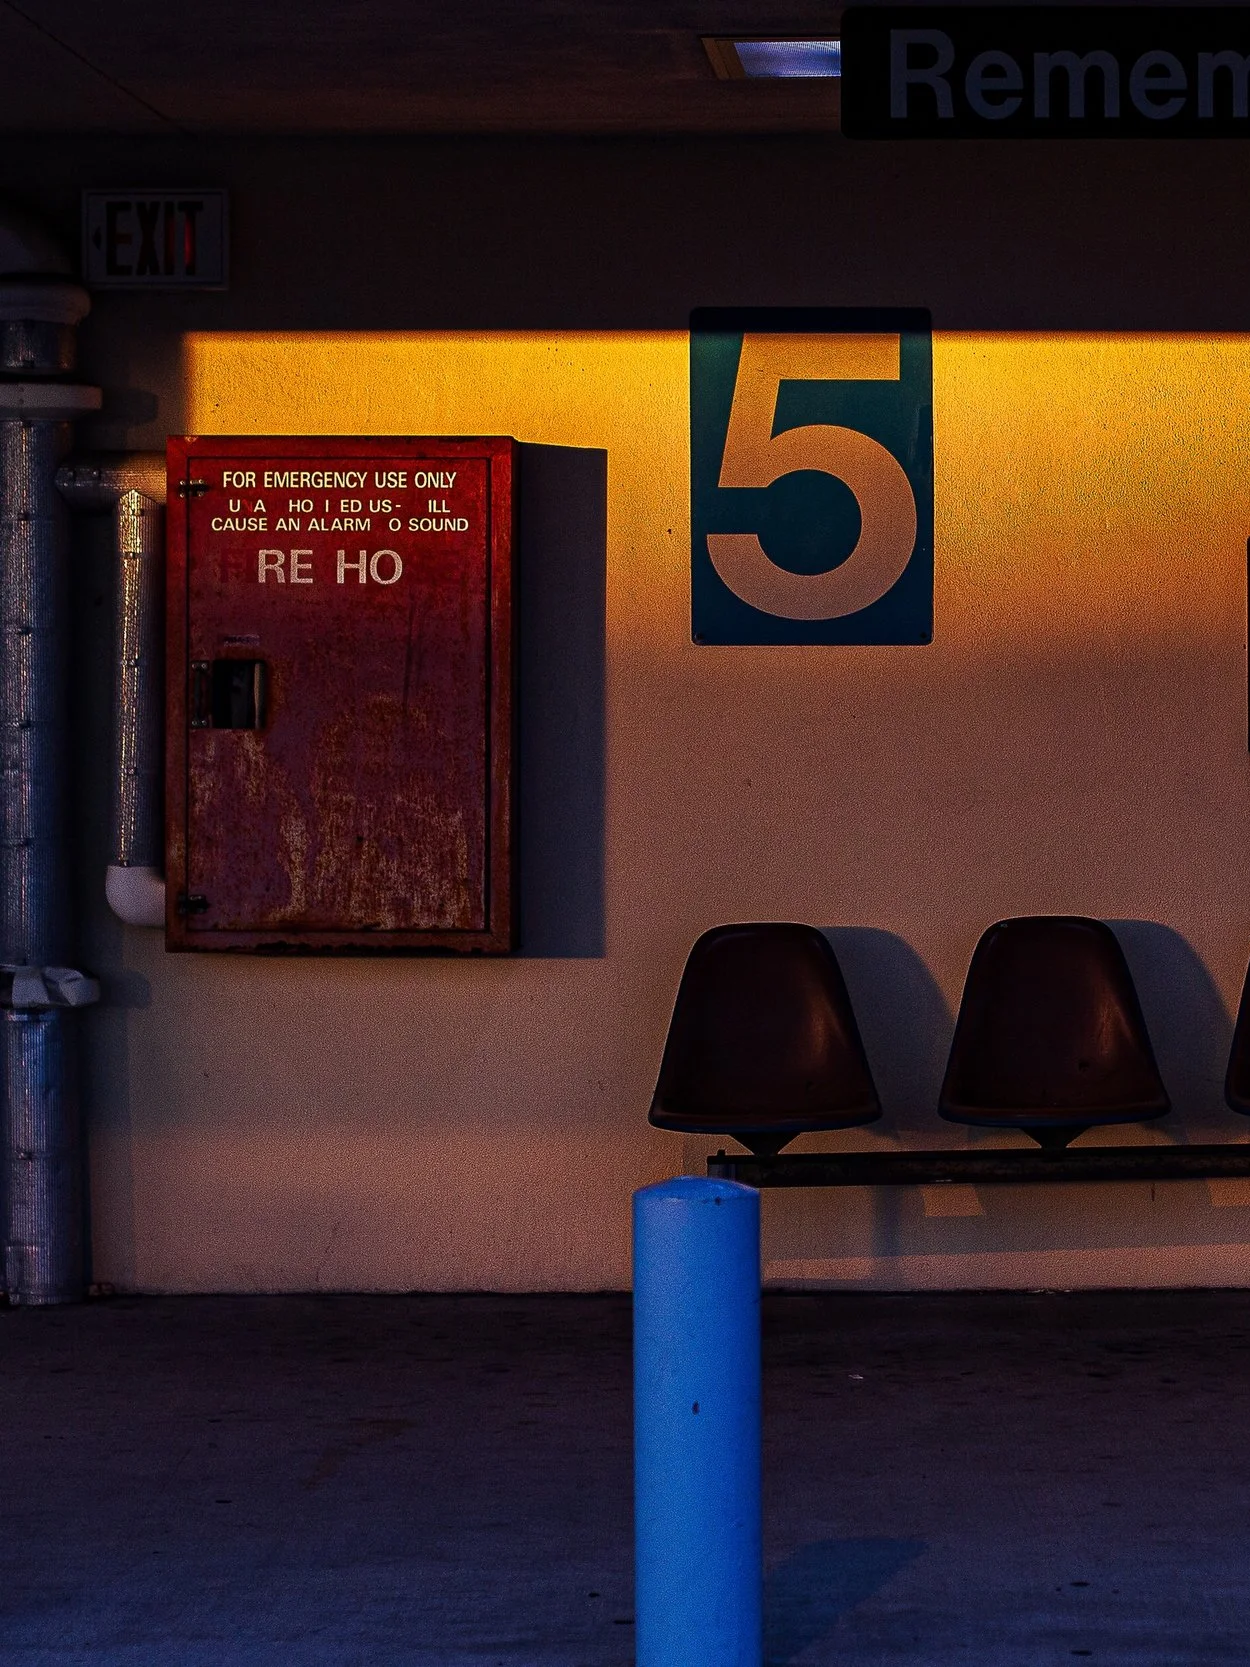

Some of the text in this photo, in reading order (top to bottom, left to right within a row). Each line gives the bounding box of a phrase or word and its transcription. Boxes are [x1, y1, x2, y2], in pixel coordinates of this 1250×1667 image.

[106, 201, 203, 275] EXIT
[223, 471, 457, 489] FOR EMERGENCY USE ONLY
[707, 332, 917, 621] 5
[428, 499, 451, 513] ILL
[211, 517, 469, 532] CAUSE AN ALARM O SOUND
[257, 548, 403, 585] RE HO
